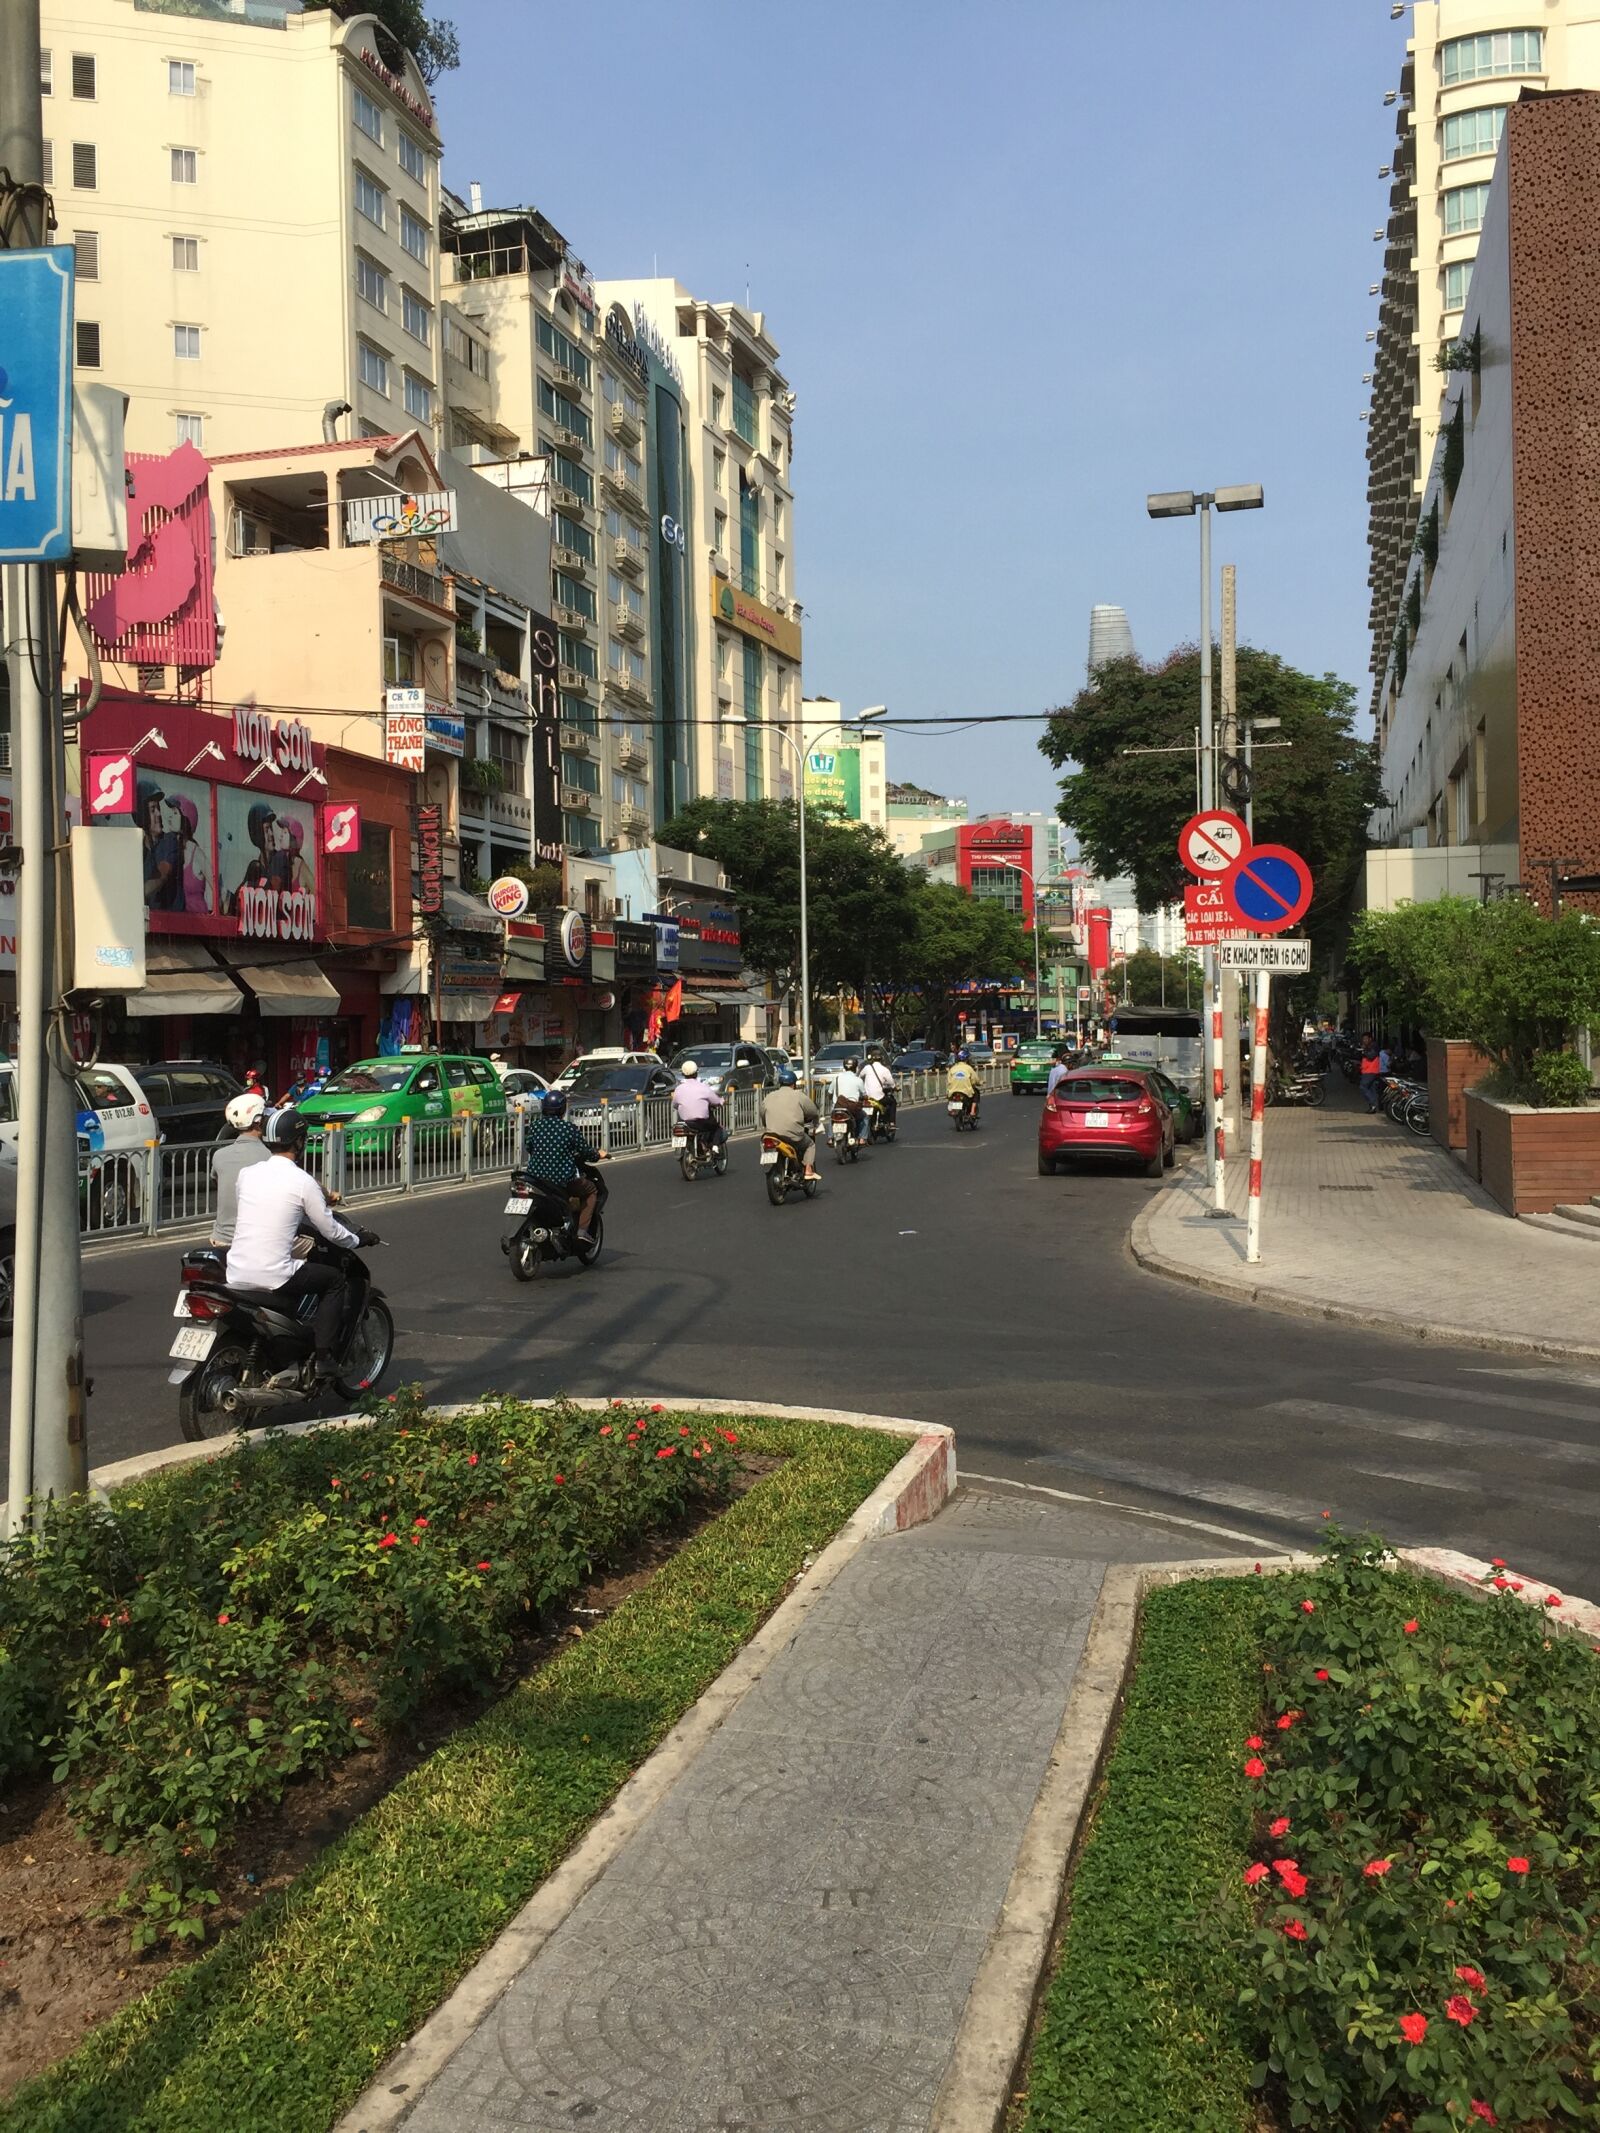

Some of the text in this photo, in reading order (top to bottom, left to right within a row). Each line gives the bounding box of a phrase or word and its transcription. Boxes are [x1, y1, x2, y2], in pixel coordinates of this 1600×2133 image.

[392, 690, 419, 701] CH 78
[275, 717, 314, 773] SƠN
[388, 735, 422, 750] THANH
[493, 884, 519, 900] BURGER
[495, 890, 522, 909] KING
[238, 878, 315, 940] NÓN SƠN
[1186, 910, 1228, 926] CÁC LOẠI XE 3
[1195, 930, 1203, 941] XE
[1222, 947, 1231, 964] XE
[1234, 944, 1258, 964] KHÁCH
[1260, 945, 1279, 965] TRÊN
[1282, 949, 1290, 965] 16
[102, 1110, 113, 1121] 51F
